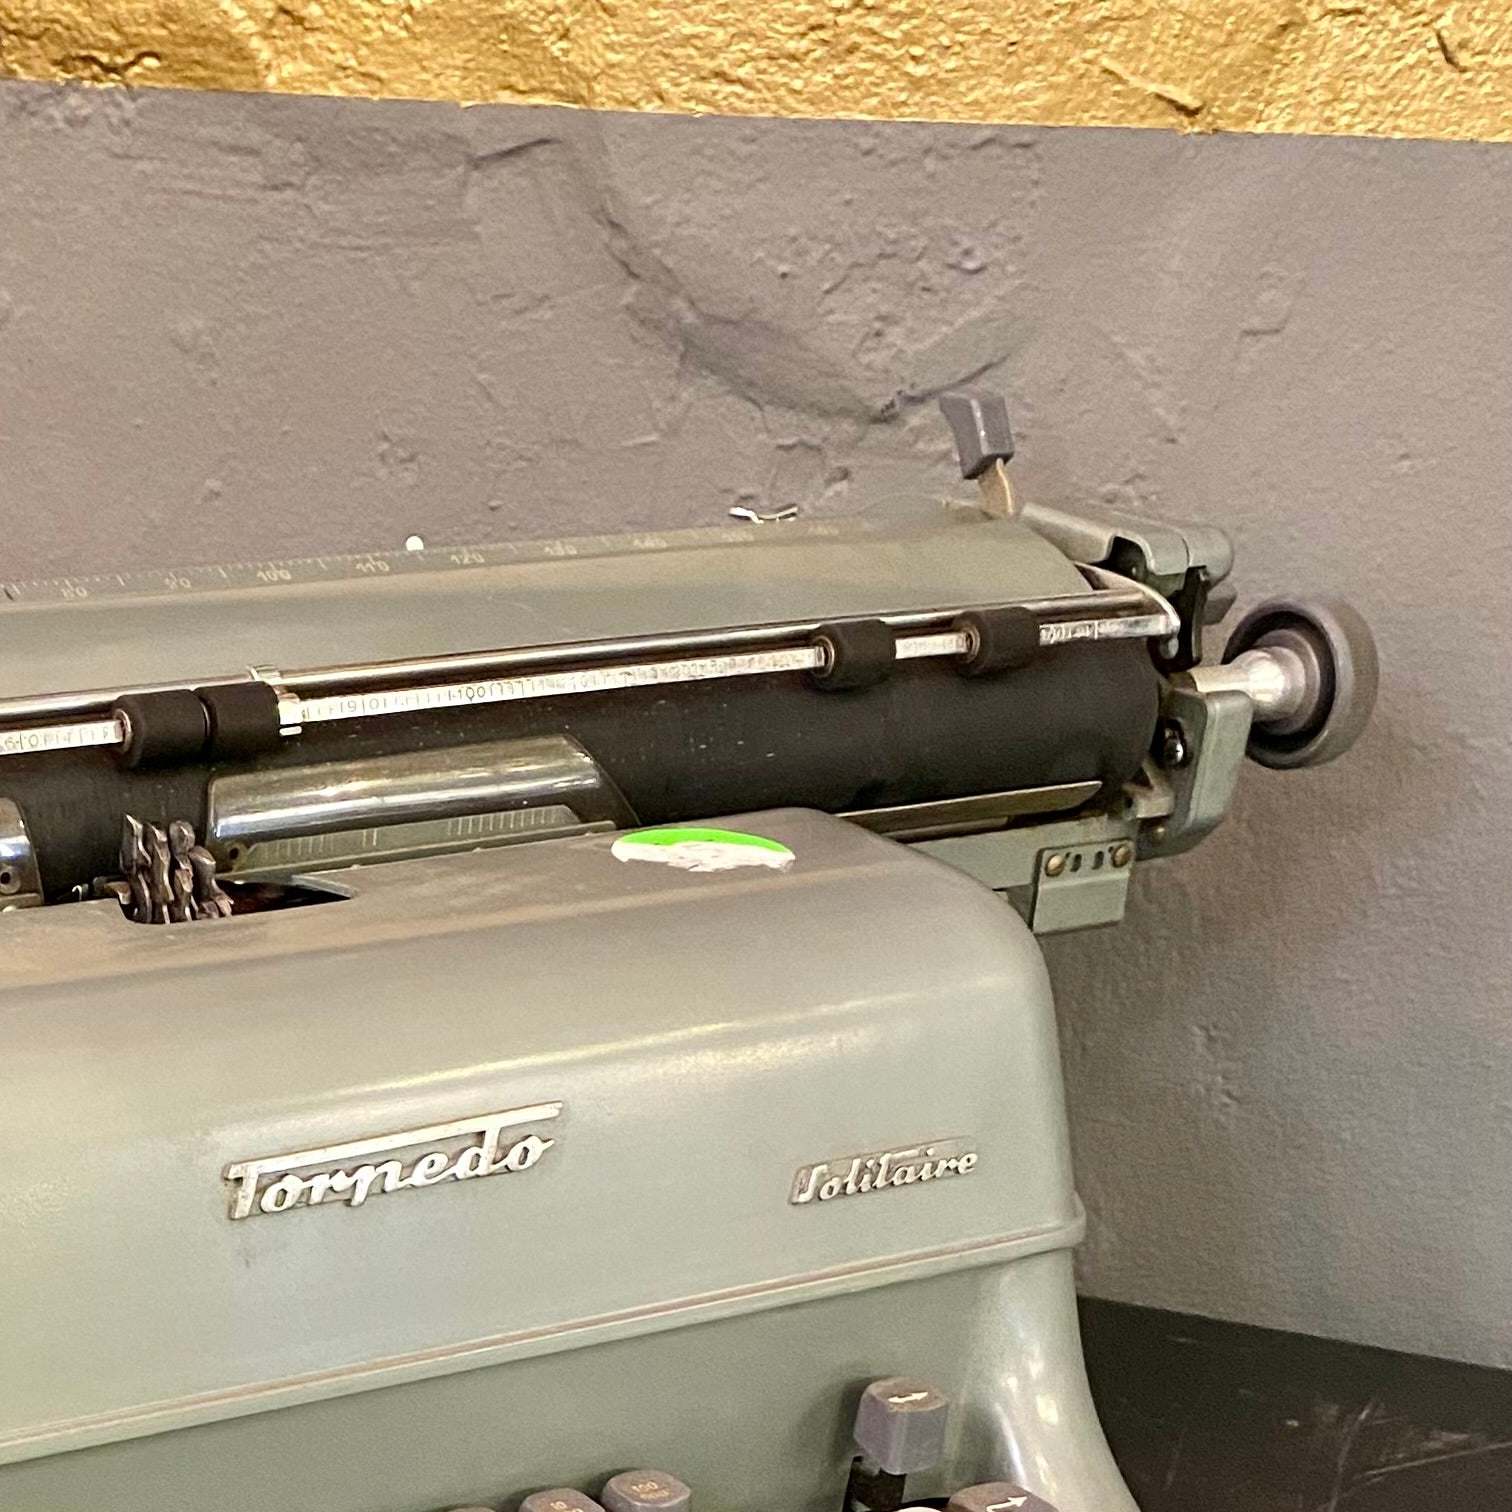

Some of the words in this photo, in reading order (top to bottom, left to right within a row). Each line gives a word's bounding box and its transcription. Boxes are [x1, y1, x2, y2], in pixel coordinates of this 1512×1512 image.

[449, 552, 486, 565] 120
[355, 561, 390, 574] 110
[256, 568, 293, 582] 100
[224, 1100, 564, 1221] Torpedo
[791, 1146, 978, 1205] Solitaire
